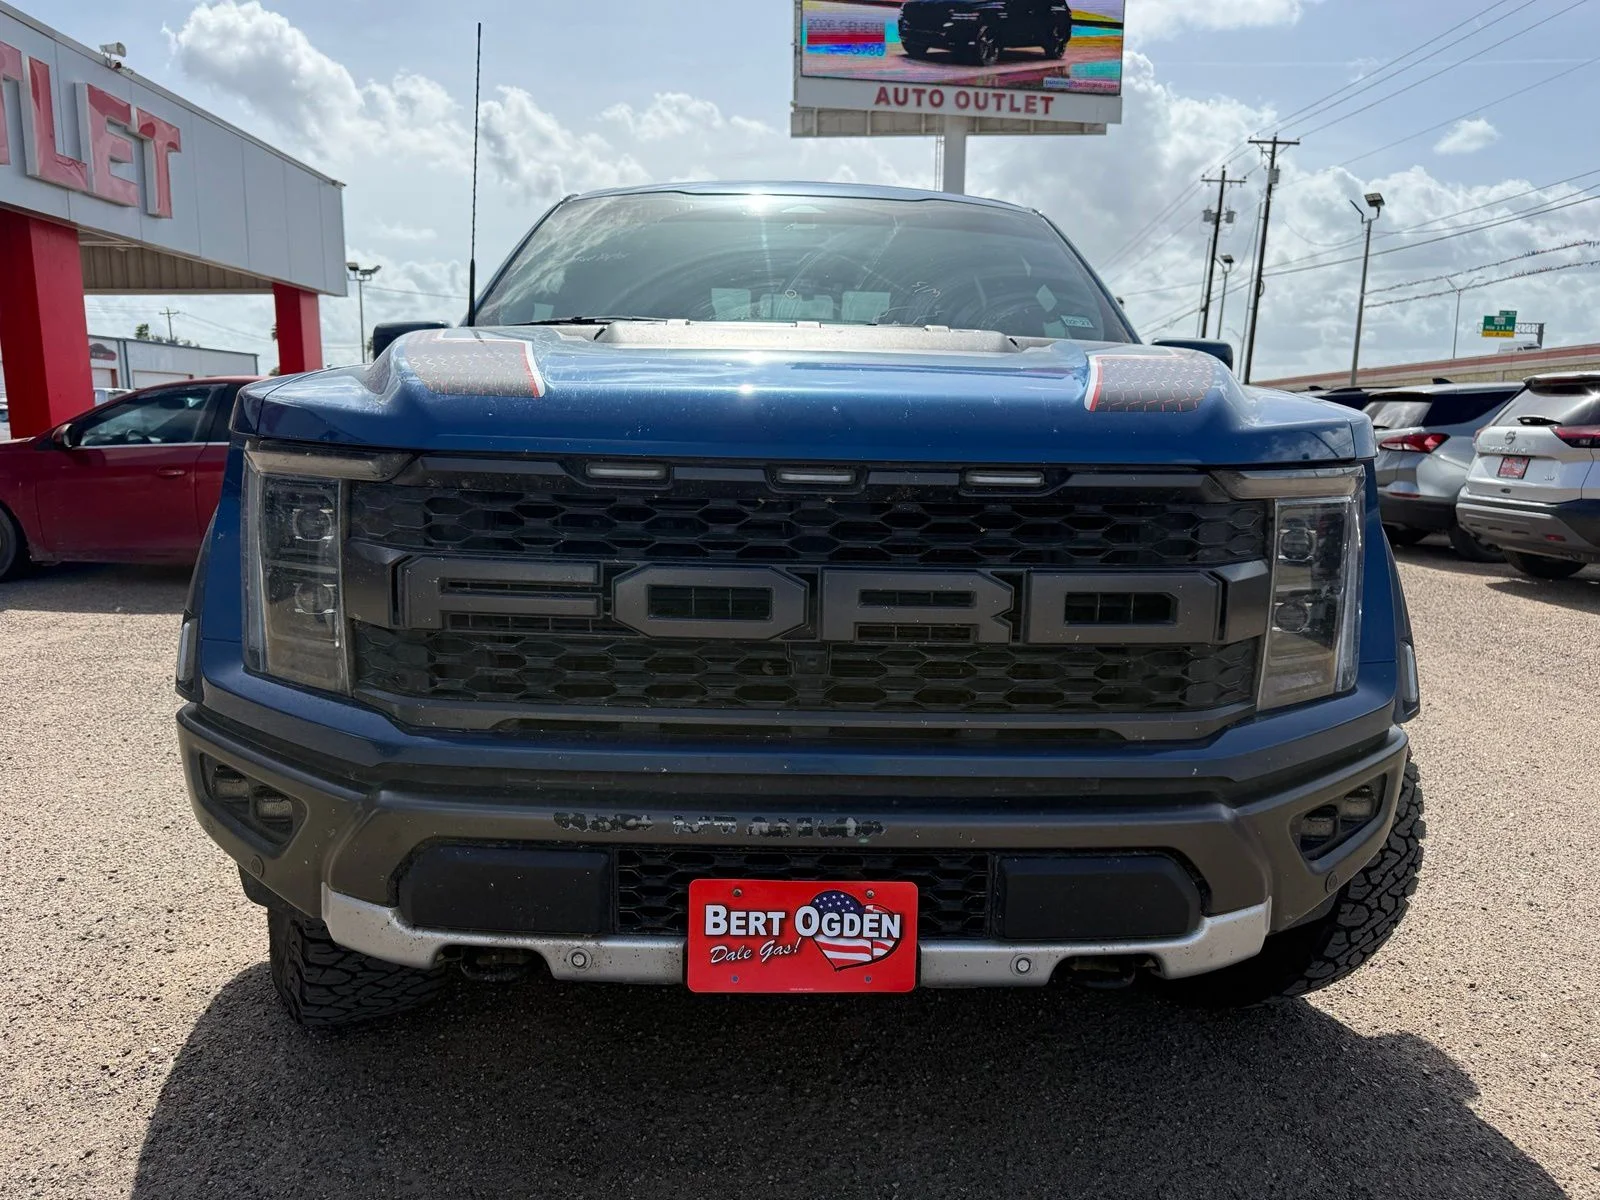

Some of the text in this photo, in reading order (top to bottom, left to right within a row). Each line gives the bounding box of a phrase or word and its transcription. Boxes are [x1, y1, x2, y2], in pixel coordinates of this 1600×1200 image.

[874, 86, 1055, 115] AUTO OUTLET
[403, 556, 1219, 645] FORD
[705, 904, 901, 938] BERT OGDEN
[710, 937, 802, 964] Dale Gas!
